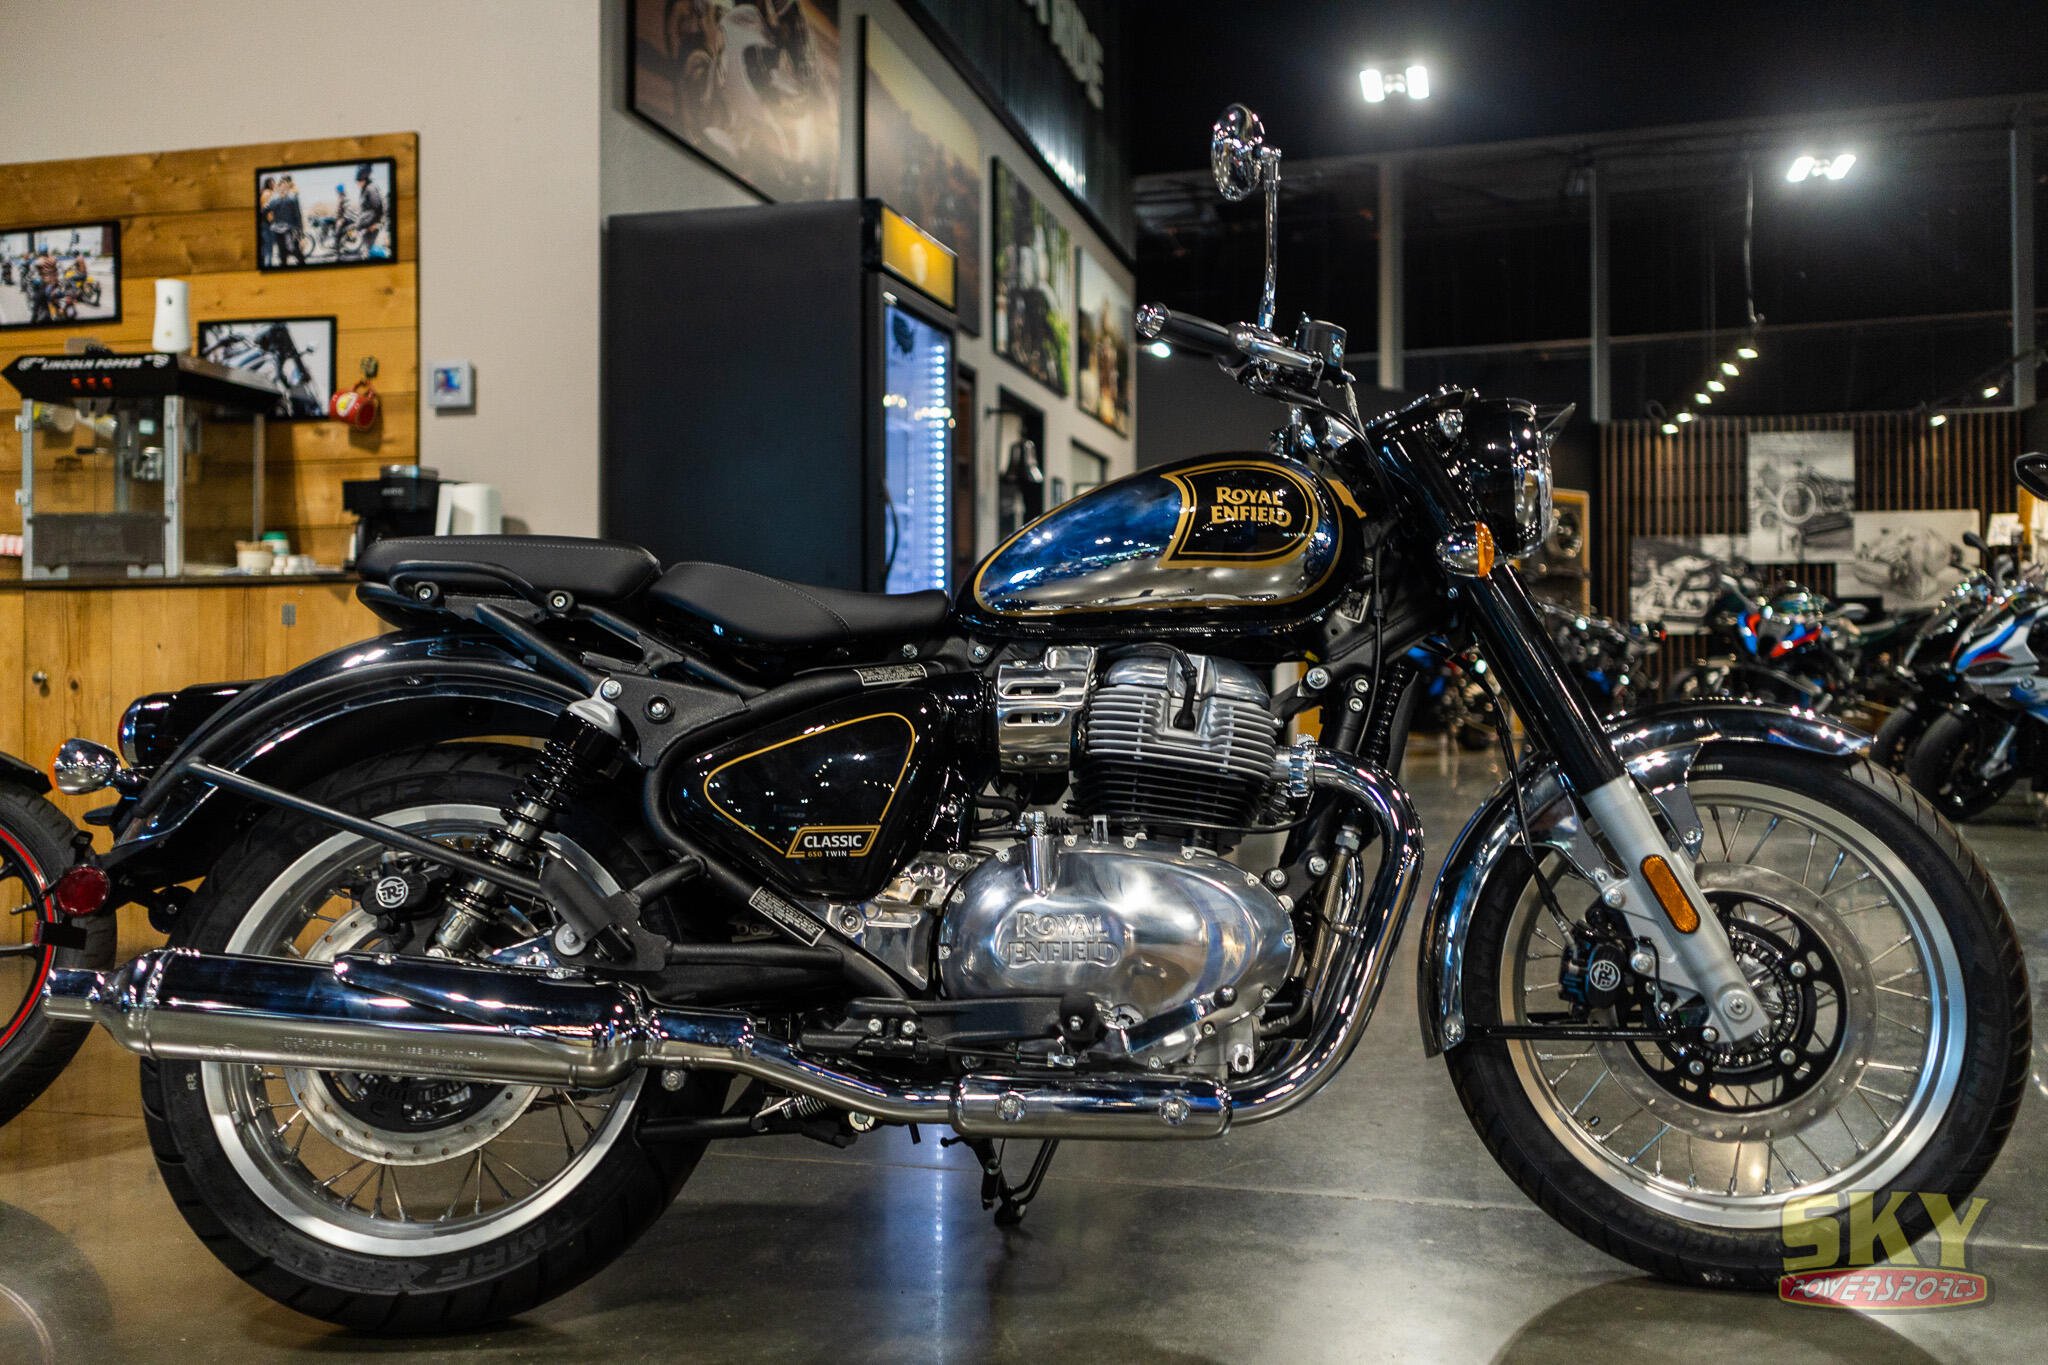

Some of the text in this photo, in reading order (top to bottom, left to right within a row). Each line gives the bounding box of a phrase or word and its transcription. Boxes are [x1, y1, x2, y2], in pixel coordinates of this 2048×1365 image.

[95, 358, 142, 369] POPPER
[1216, 486, 1284, 506] ROYAL
[1211, 505, 1292, 527] ENFIELD
[804, 835, 862, 848] CLASSIC
[1016, 911, 1109, 940] ROYAL
[1008, 941, 1120, 968] ENFIELD
